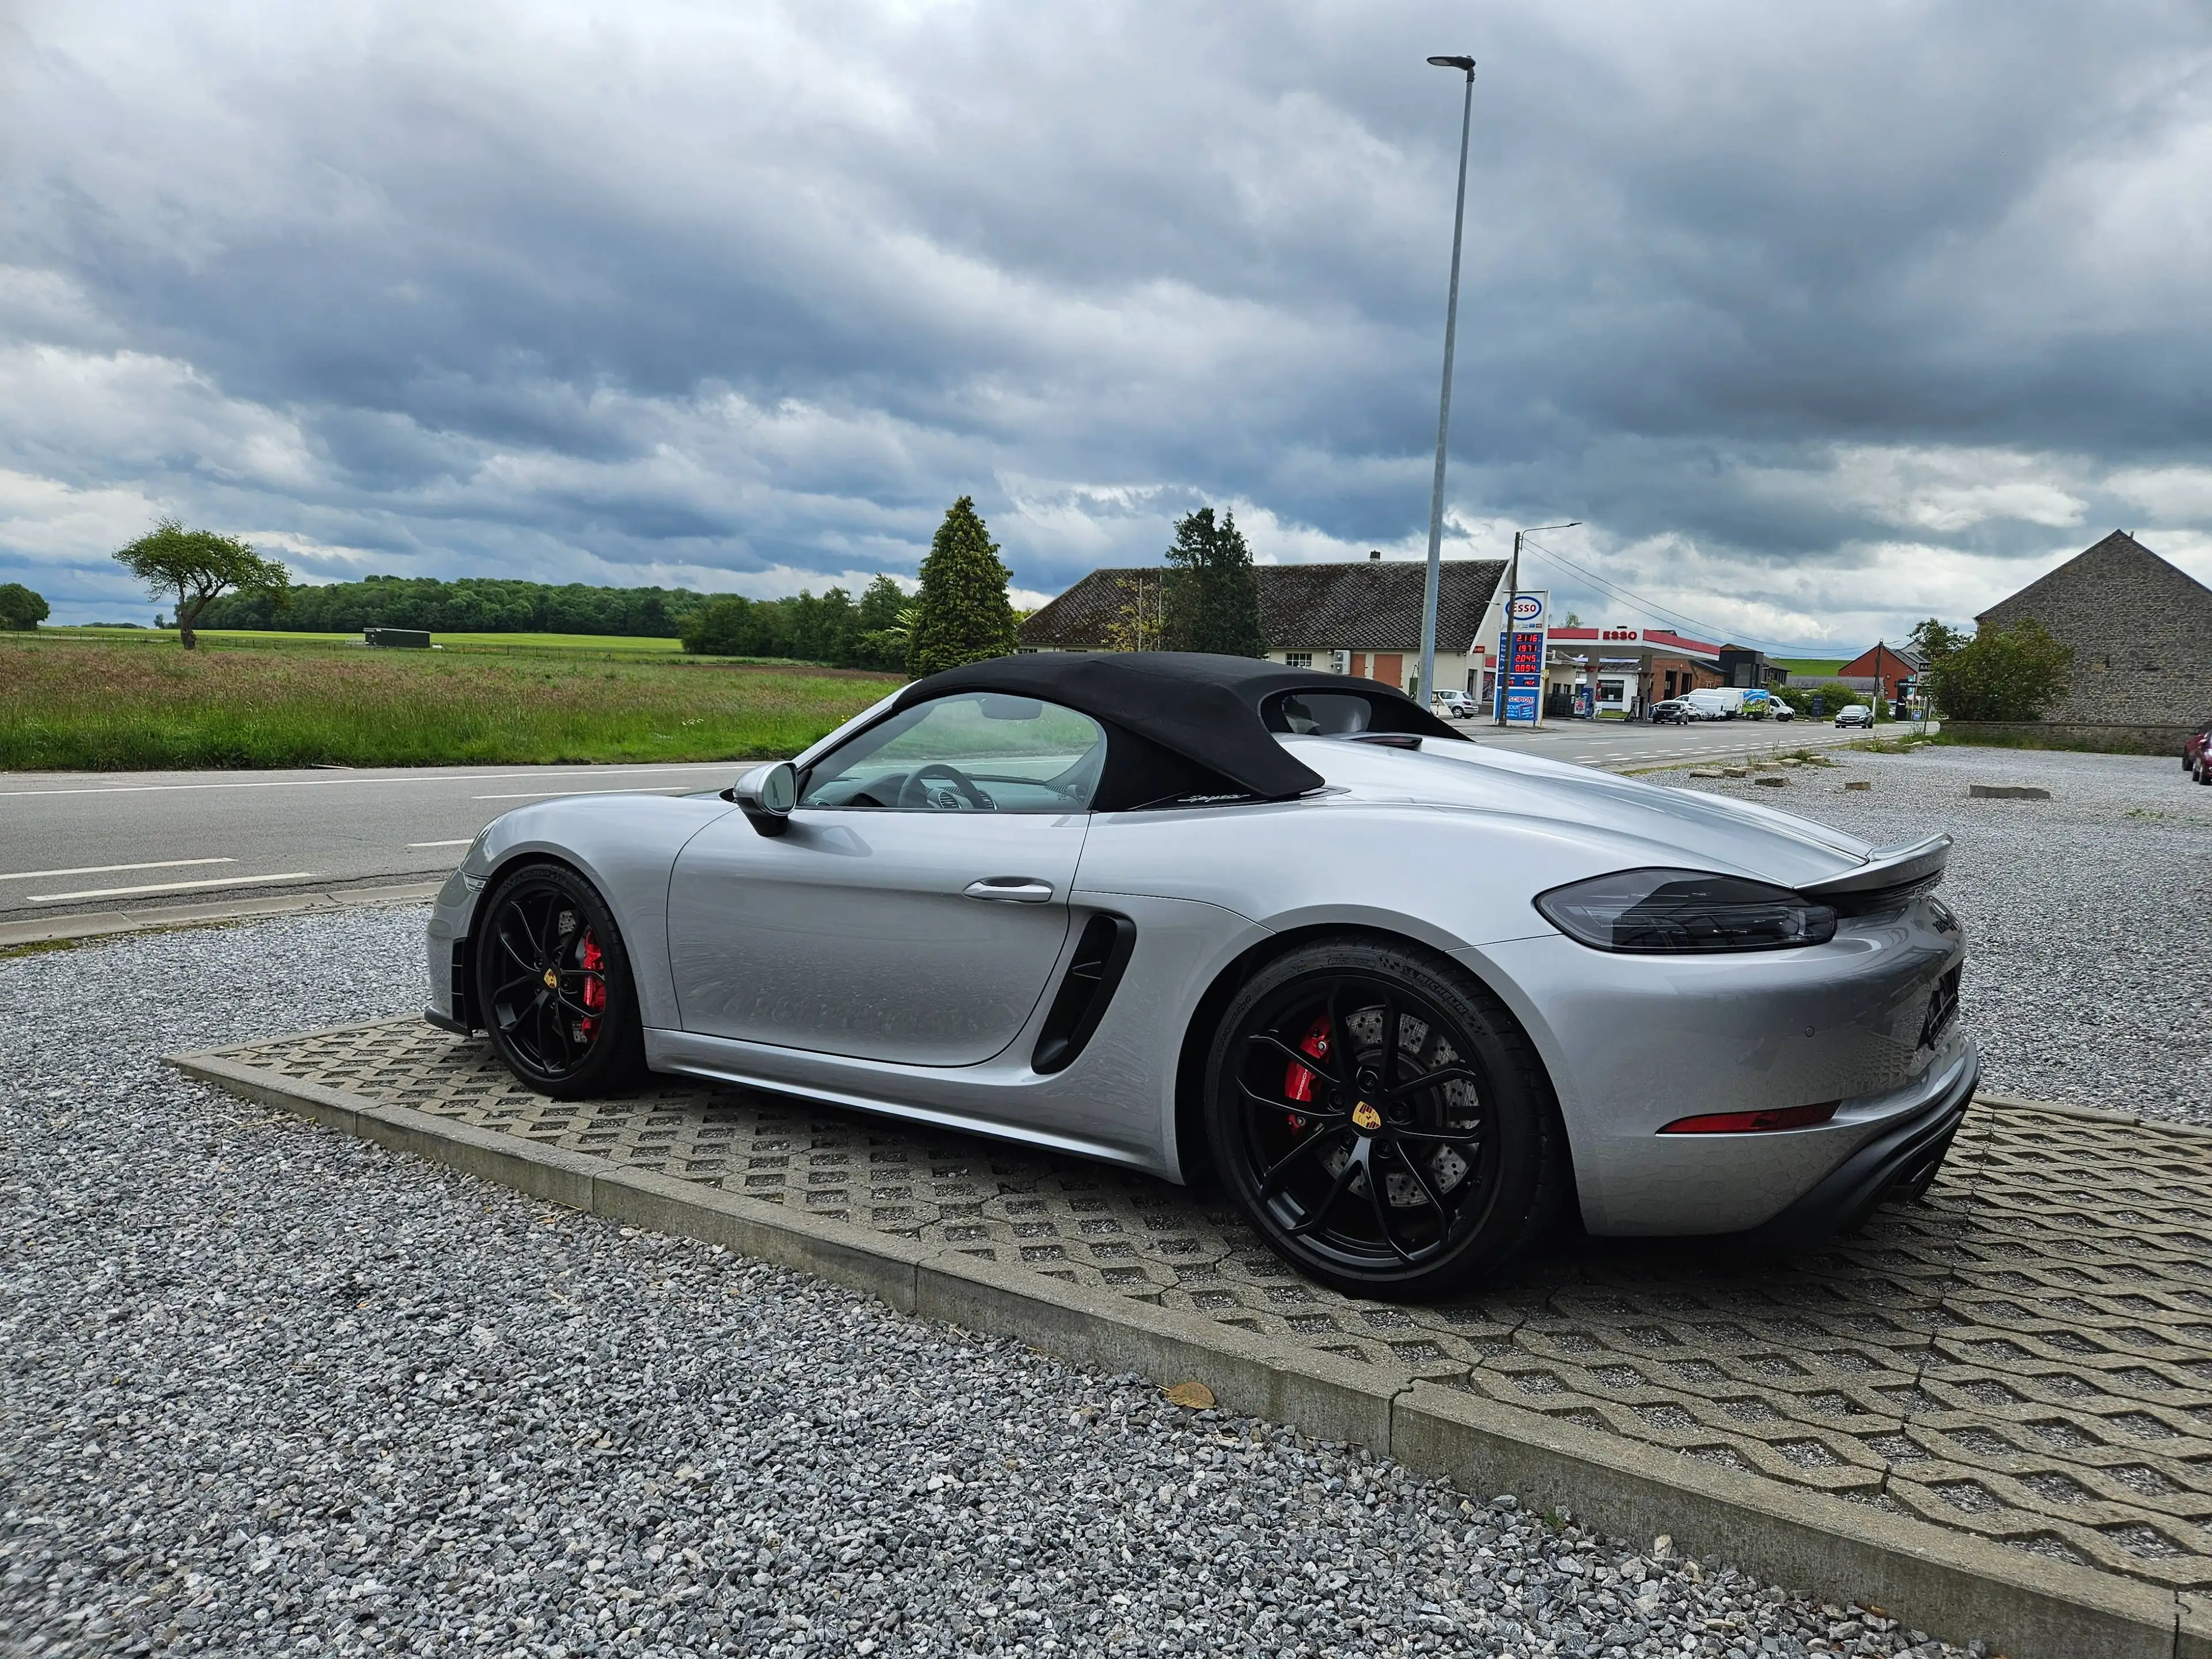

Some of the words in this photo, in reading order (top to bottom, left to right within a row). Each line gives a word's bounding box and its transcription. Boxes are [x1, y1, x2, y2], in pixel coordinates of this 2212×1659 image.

[1603, 631, 1637, 640] ESSO
[1416, 974, 1467, 1014] MICHELIN
[1296, 1069, 1308, 1100] PORSCH
